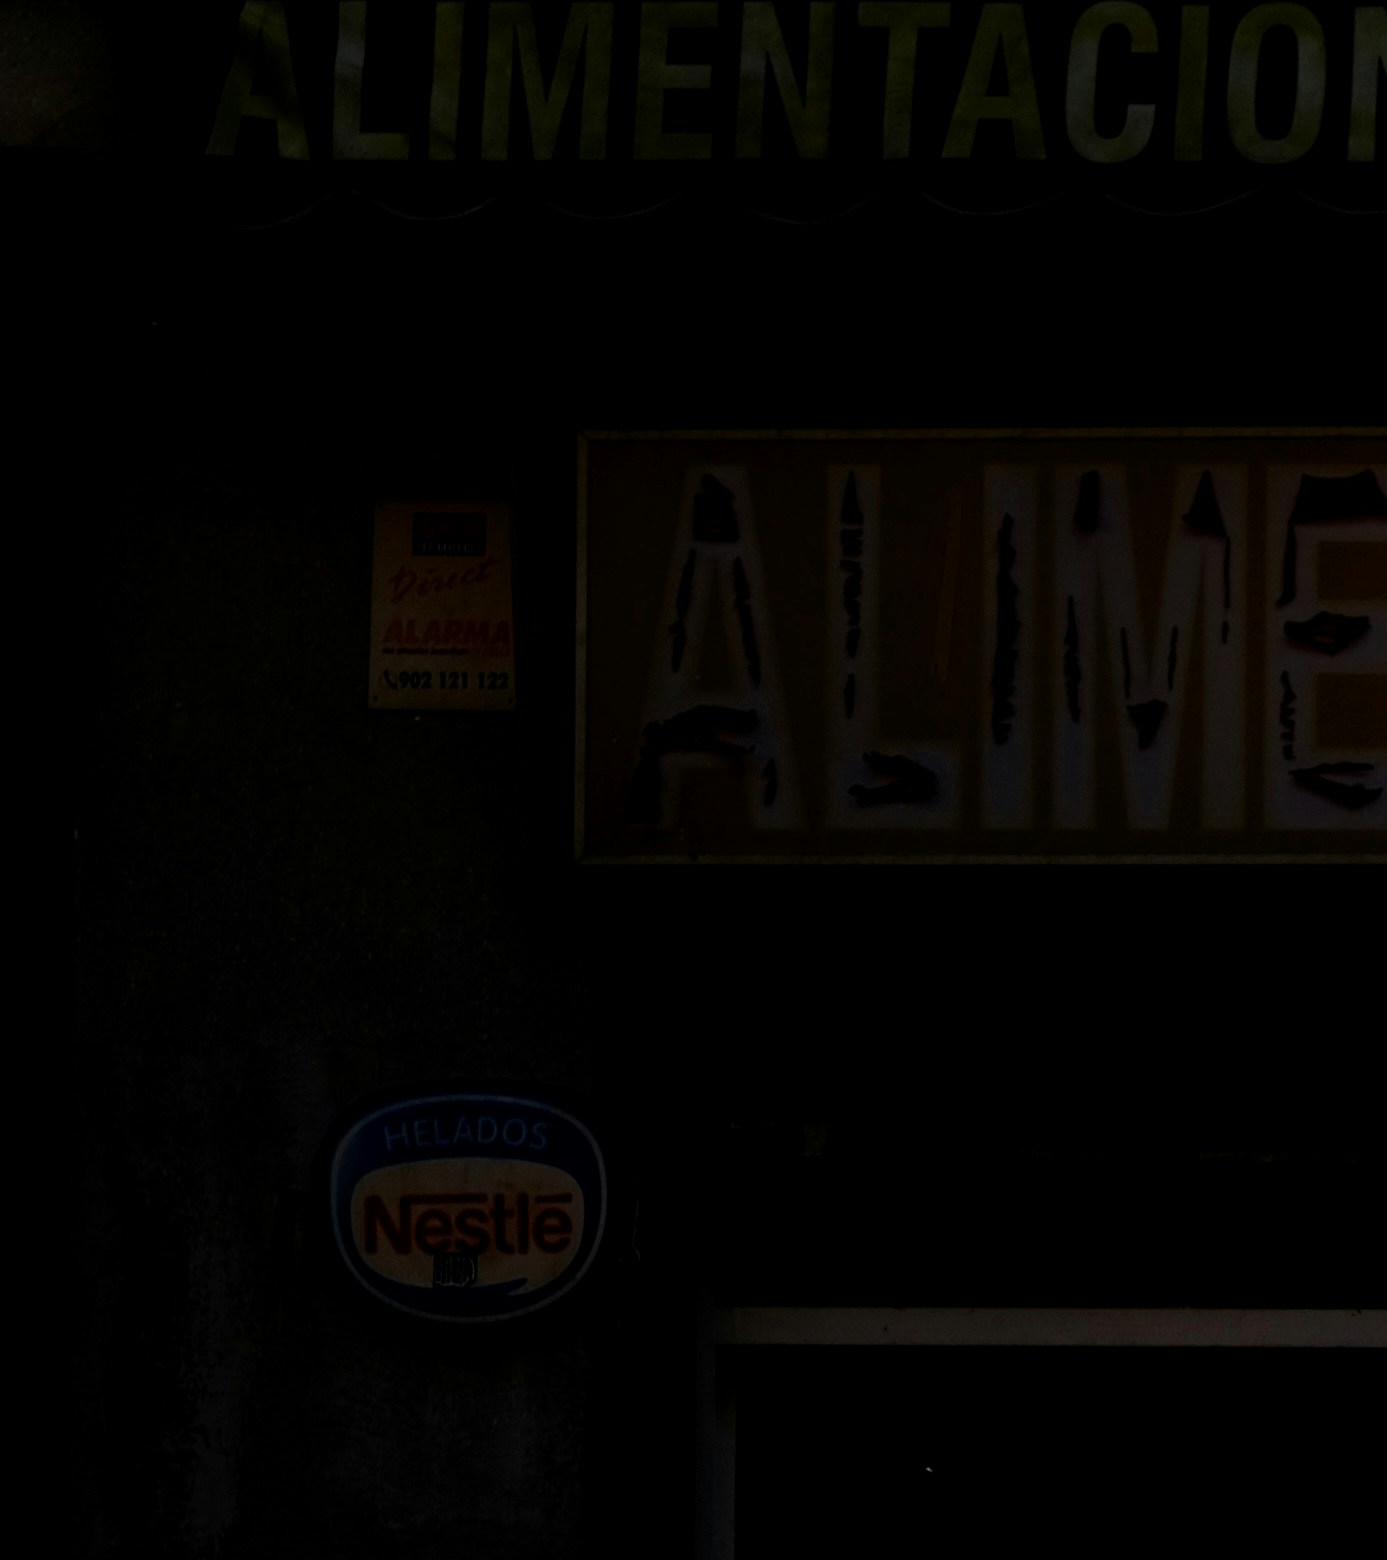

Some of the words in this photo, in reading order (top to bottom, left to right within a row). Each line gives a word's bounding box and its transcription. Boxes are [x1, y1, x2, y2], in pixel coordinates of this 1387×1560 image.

[382, 618, 513, 645] ALARMA
[399, 671, 432, 690] 902
[439, 671, 469, 689] 121
[478, 671, 509, 690] 122
[383, 1115, 550, 1152] HELADOS
